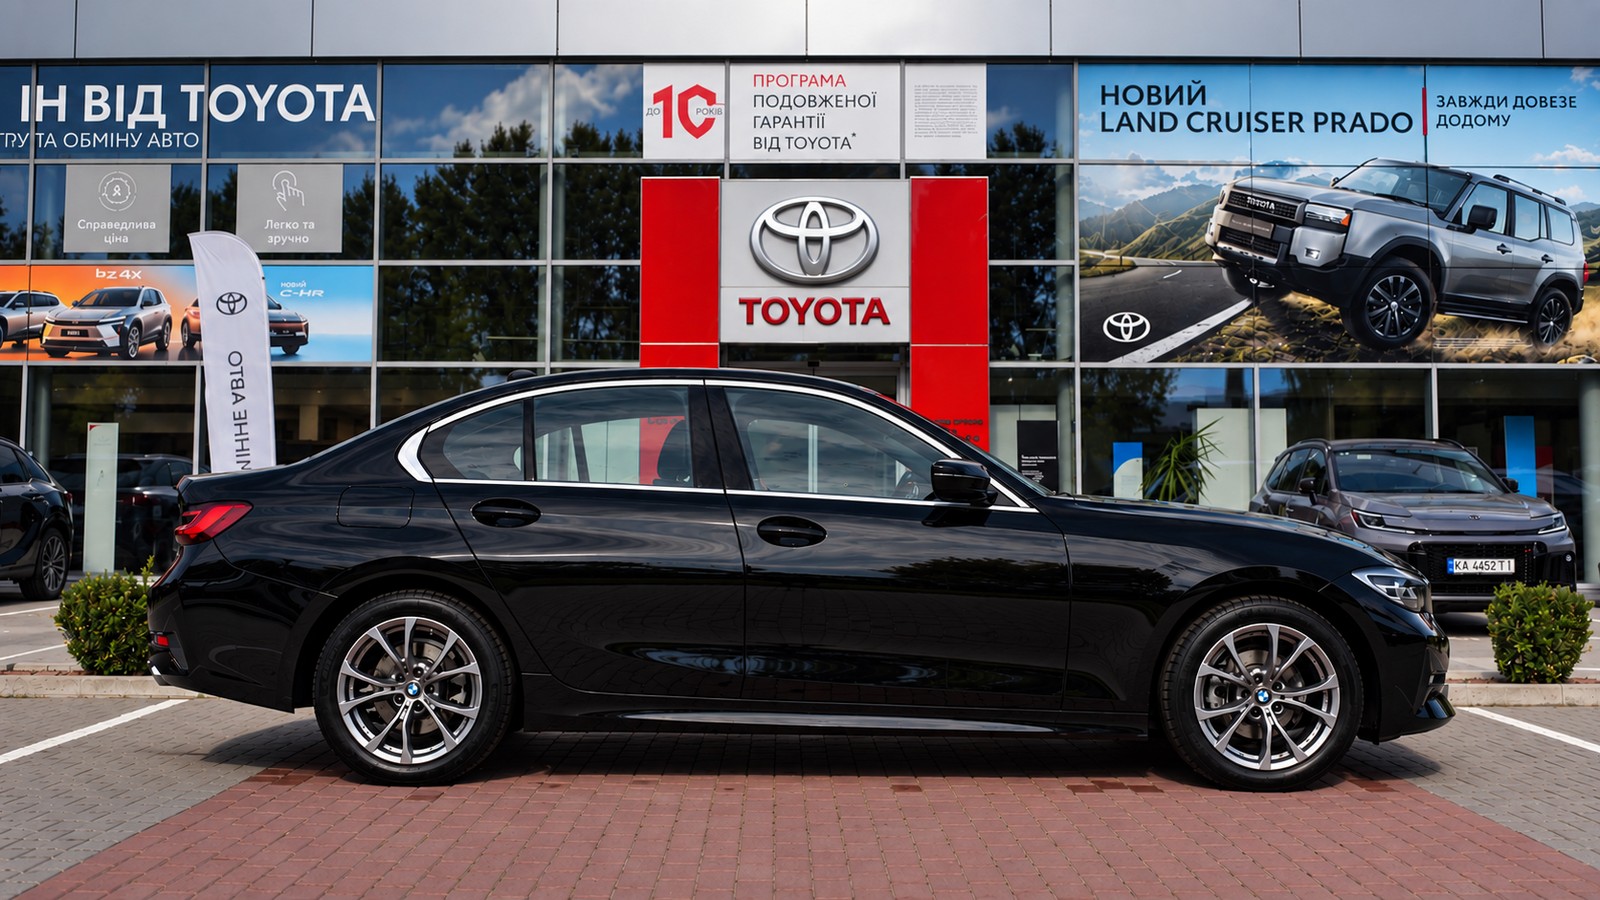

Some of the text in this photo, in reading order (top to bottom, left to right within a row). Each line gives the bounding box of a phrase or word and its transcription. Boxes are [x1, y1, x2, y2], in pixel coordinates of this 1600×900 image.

[753, 74, 847, 88] ПРОГРАМА
[753, 91, 877, 110] ПОДОВЖЕНОЇ
[1101, 80, 1206, 106] НОВИЙ
[84, 84, 167, 129] ВІД
[180, 83, 376, 122] TOYOTA
[1436, 95, 1578, 110] ЗАВЖДИ ДОВЕЗЕ
[646, 107, 661, 117] ДО
[696, 107, 723, 116] РОКІВ
[753, 112, 826, 129] ГАРАНТІЇ
[1101, 111, 1414, 134] LAND CRUISER PRADO
[1436, 114, 1511, 129] ДОДОМУ
[35, 132, 58, 148] ТА
[63, 132, 143, 148] ОБМІНУ
[147, 132, 199, 148] АВТО
[753, 136, 781, 152] ВІД
[77, 219, 156, 232] Справедлива
[264, 219, 315, 230] Легко та
[104, 233, 129, 245] ціна
[267, 235, 310, 246] зручно
[280, 289, 325, 297] C-HR
[738, 296, 891, 326] TOYOTA
